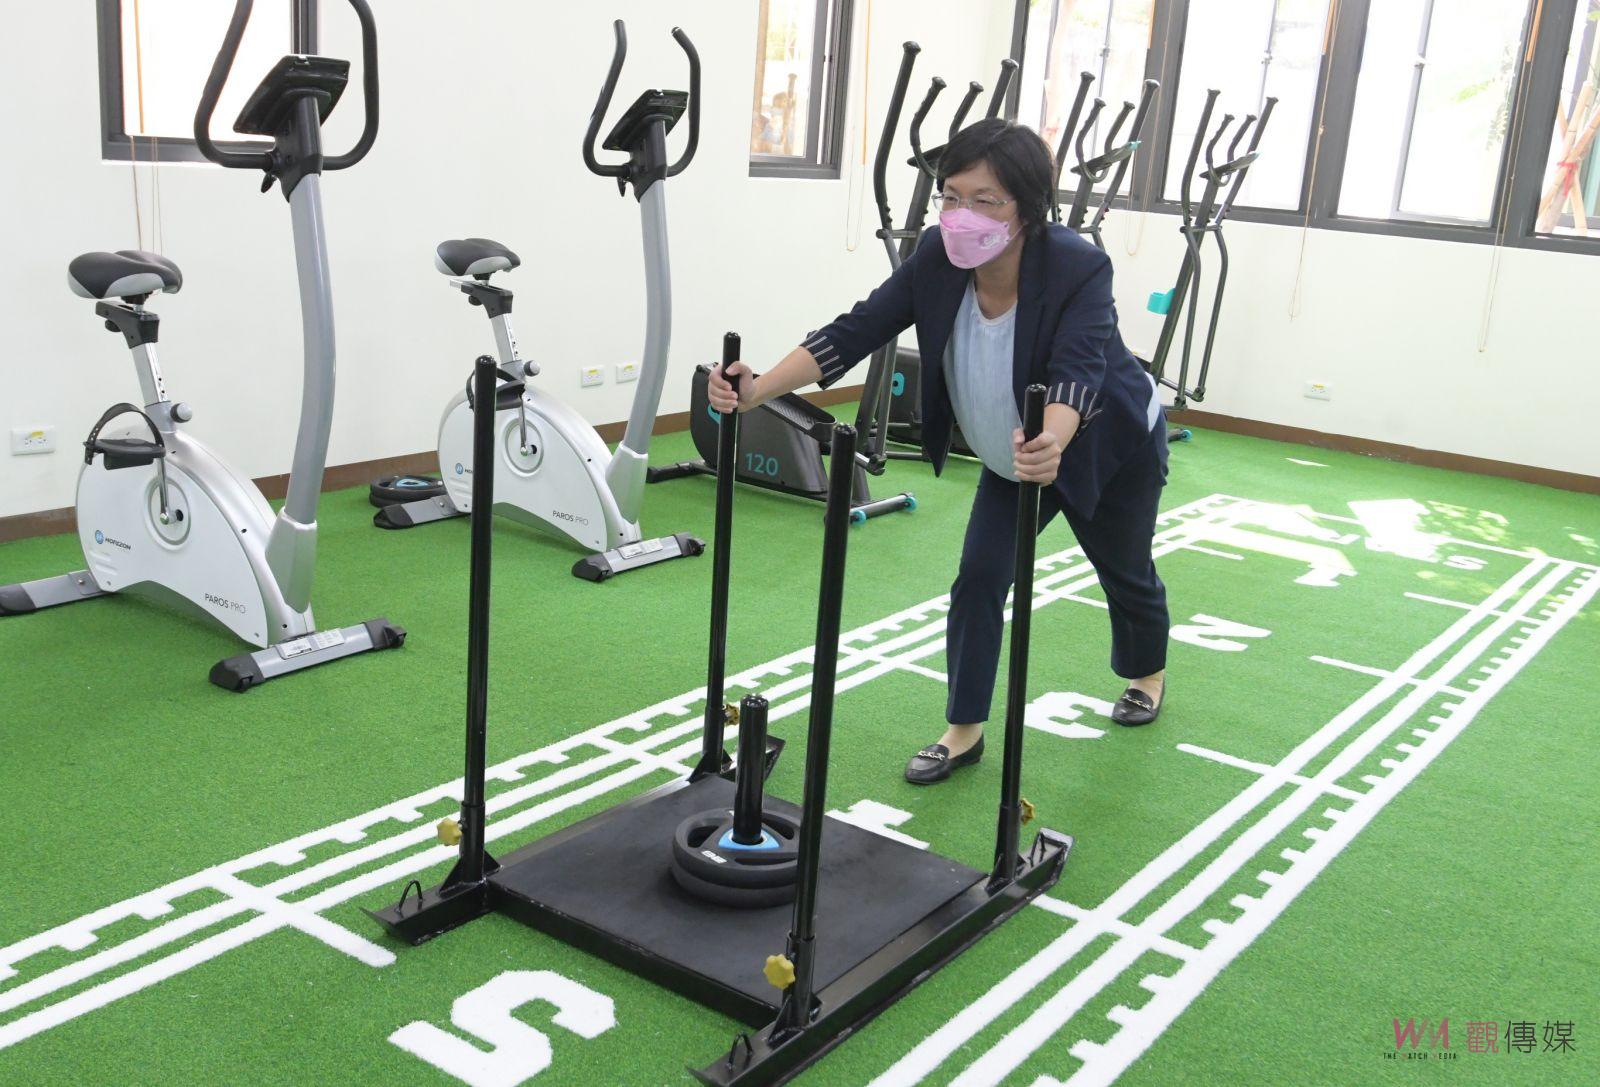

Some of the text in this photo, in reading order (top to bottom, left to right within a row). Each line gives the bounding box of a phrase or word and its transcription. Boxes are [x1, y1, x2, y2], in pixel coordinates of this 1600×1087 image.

[744, 452, 779, 476] 120
[552, 509, 574, 522] PAROS
[204, 592, 246, 614] PAROS PRO
